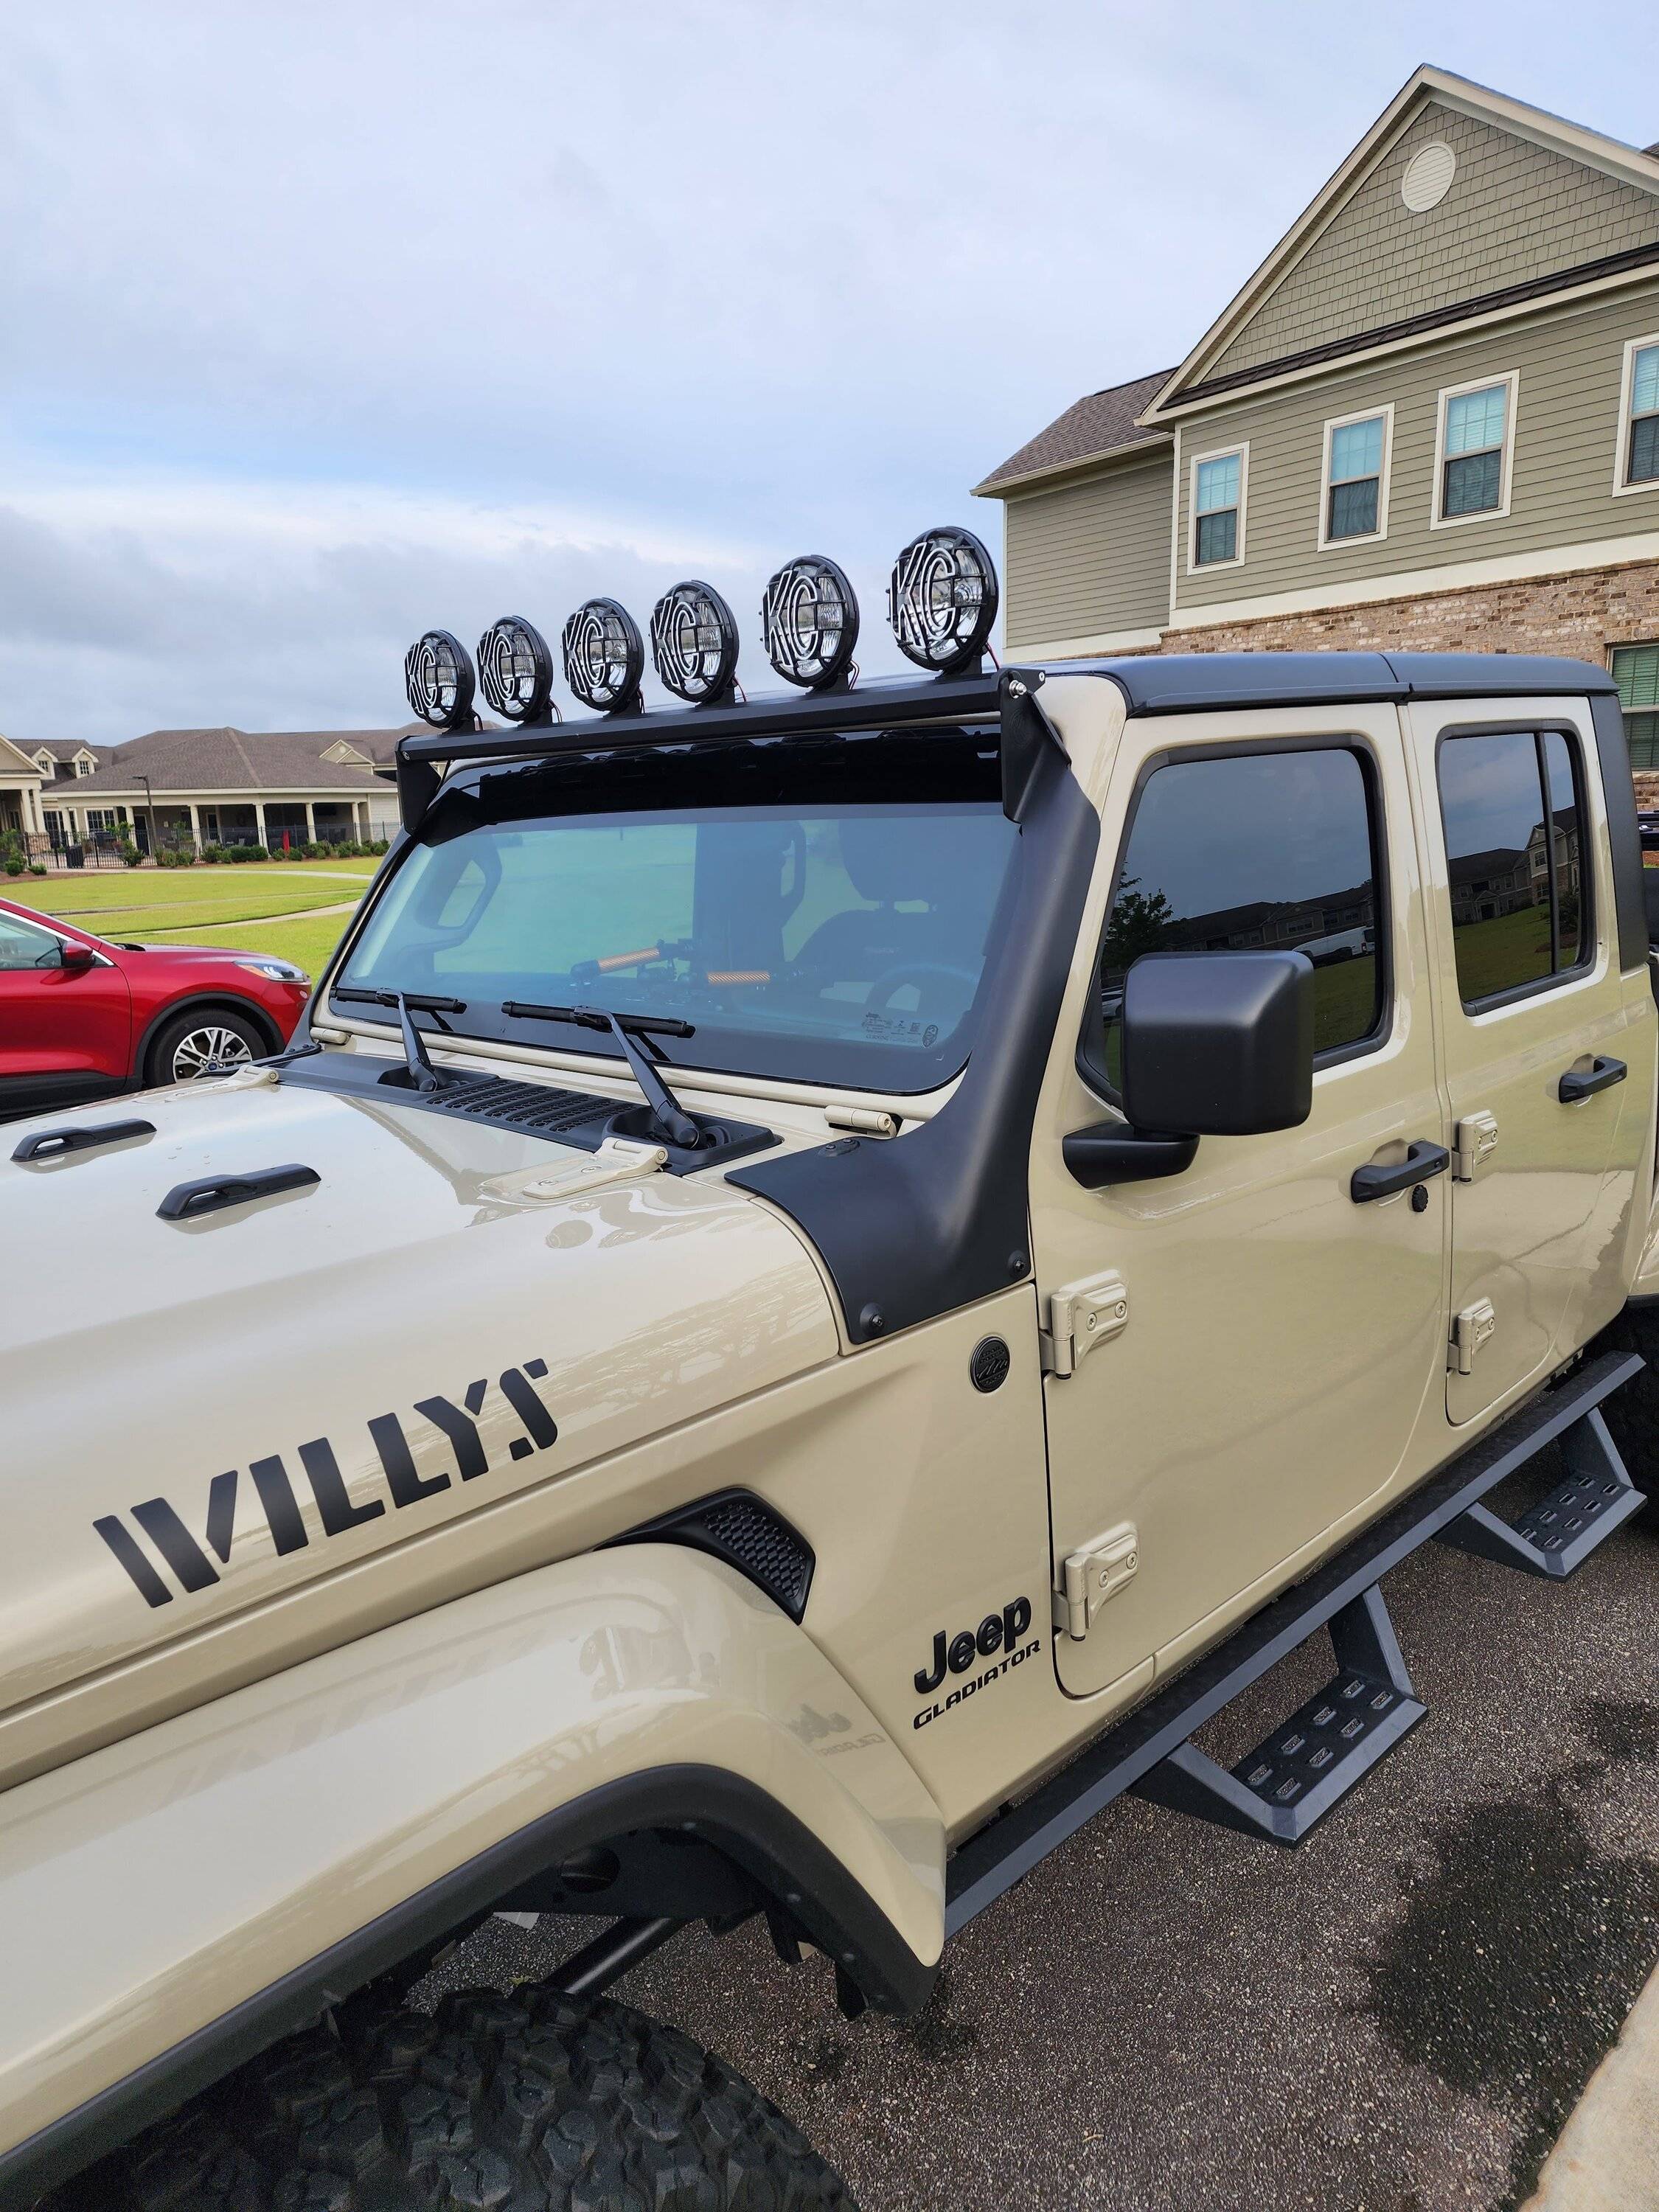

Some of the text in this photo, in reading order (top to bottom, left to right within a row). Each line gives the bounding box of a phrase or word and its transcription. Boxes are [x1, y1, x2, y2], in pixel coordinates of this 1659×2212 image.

[653, 596, 699, 687] KC
[768, 569, 819, 667] KC
[891, 542, 957, 650] KC
[406, 641, 438, 714] KC
[479, 629, 515, 708] KC
[565, 611, 606, 695] KC
[93, 1358, 557, 1607] WILLYS
[914, 1596, 1032, 1694] Jeep
[914, 1639, 1041, 1730] GLADIATOR
